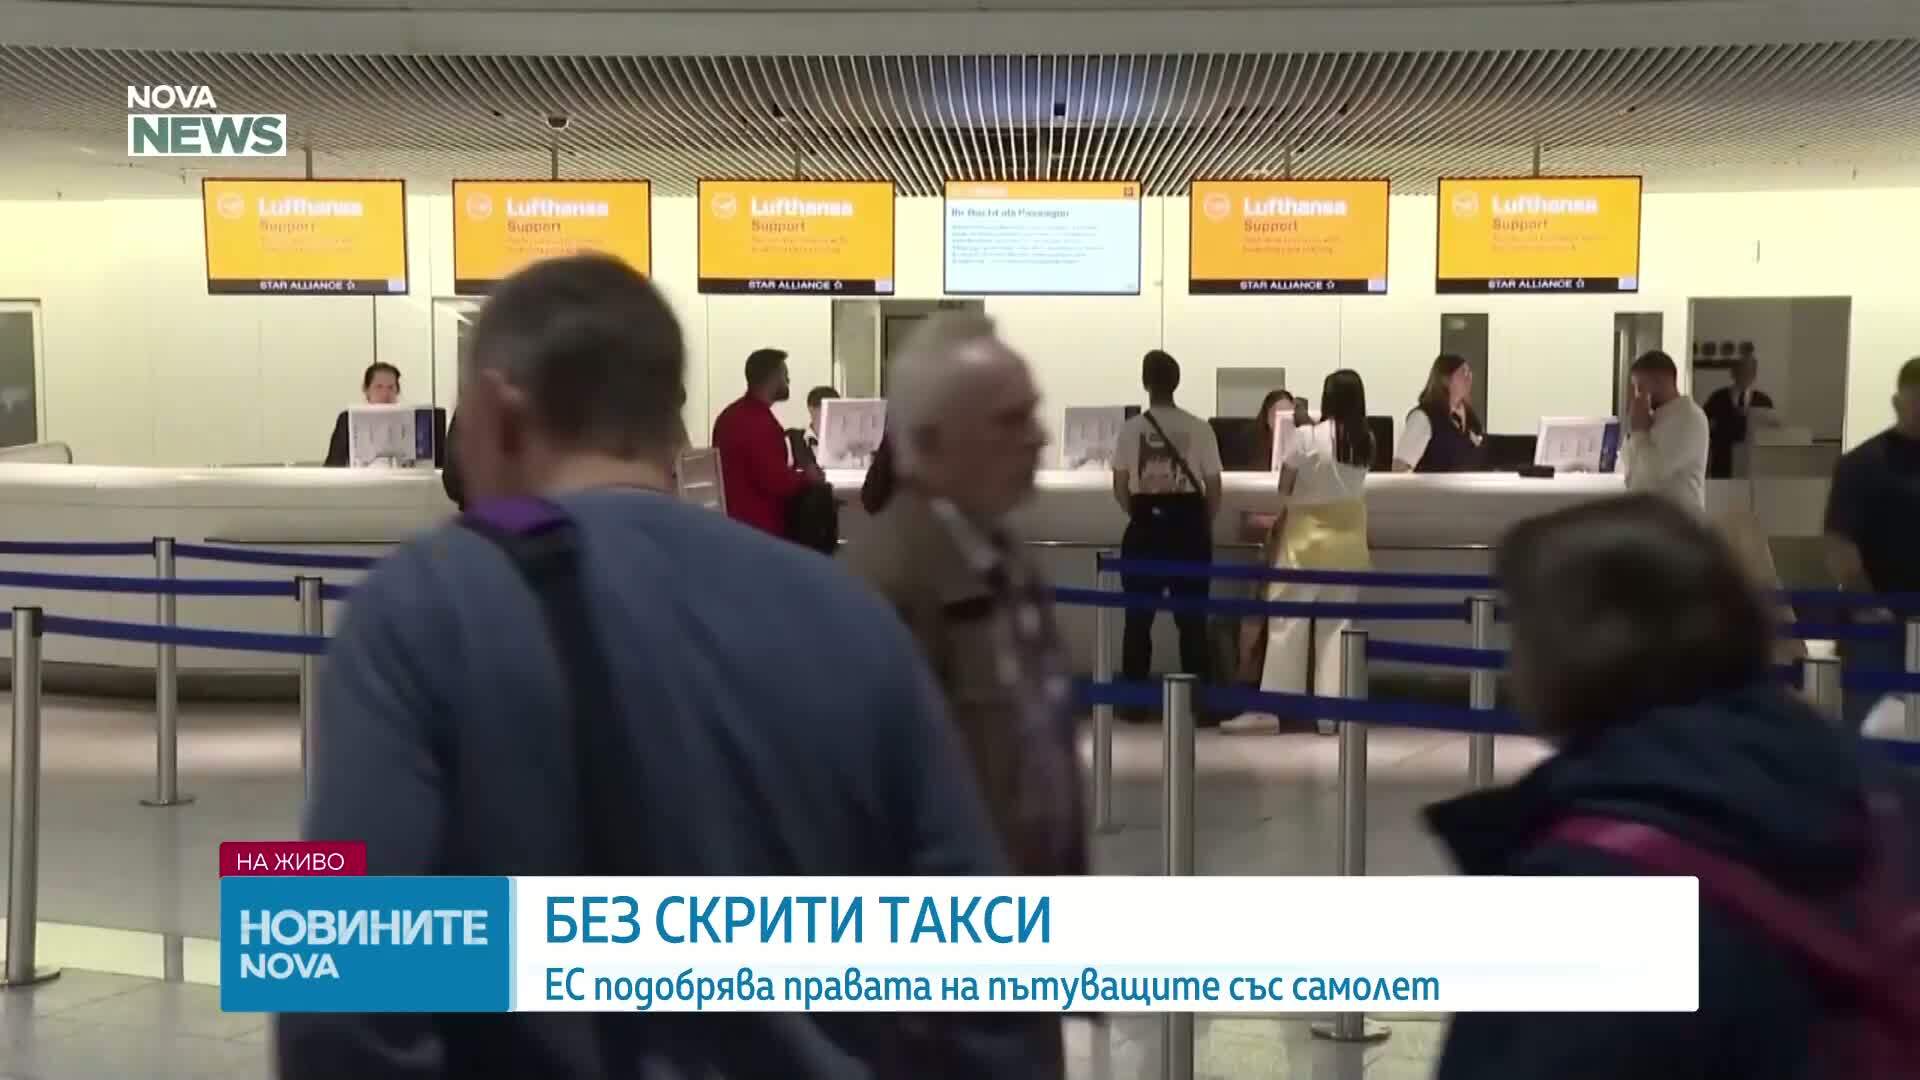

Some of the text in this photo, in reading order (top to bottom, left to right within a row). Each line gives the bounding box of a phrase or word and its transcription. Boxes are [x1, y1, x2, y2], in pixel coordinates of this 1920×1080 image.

[259, 198, 363, 217] Lufthansa
[506, 198, 609, 217] Lufthansa
[752, 197, 853, 217] Lufthansa
[1244, 197, 1347, 217] Lufthansa
[1491, 195, 1599, 214] Lufthansa
[507, 220, 561, 233] Support
[752, 219, 805, 233] Support
[1244, 220, 1298, 233] Support
[1493, 218, 1548, 231] Support
[259, 280, 343, 290] STAR ALLIANCE
[748, 280, 830, 290] STAR ALLIANCE
[1239, 280, 1323, 290] STAR ALLIANCE
[1488, 279, 1573, 289] STAR ALLIANCE
